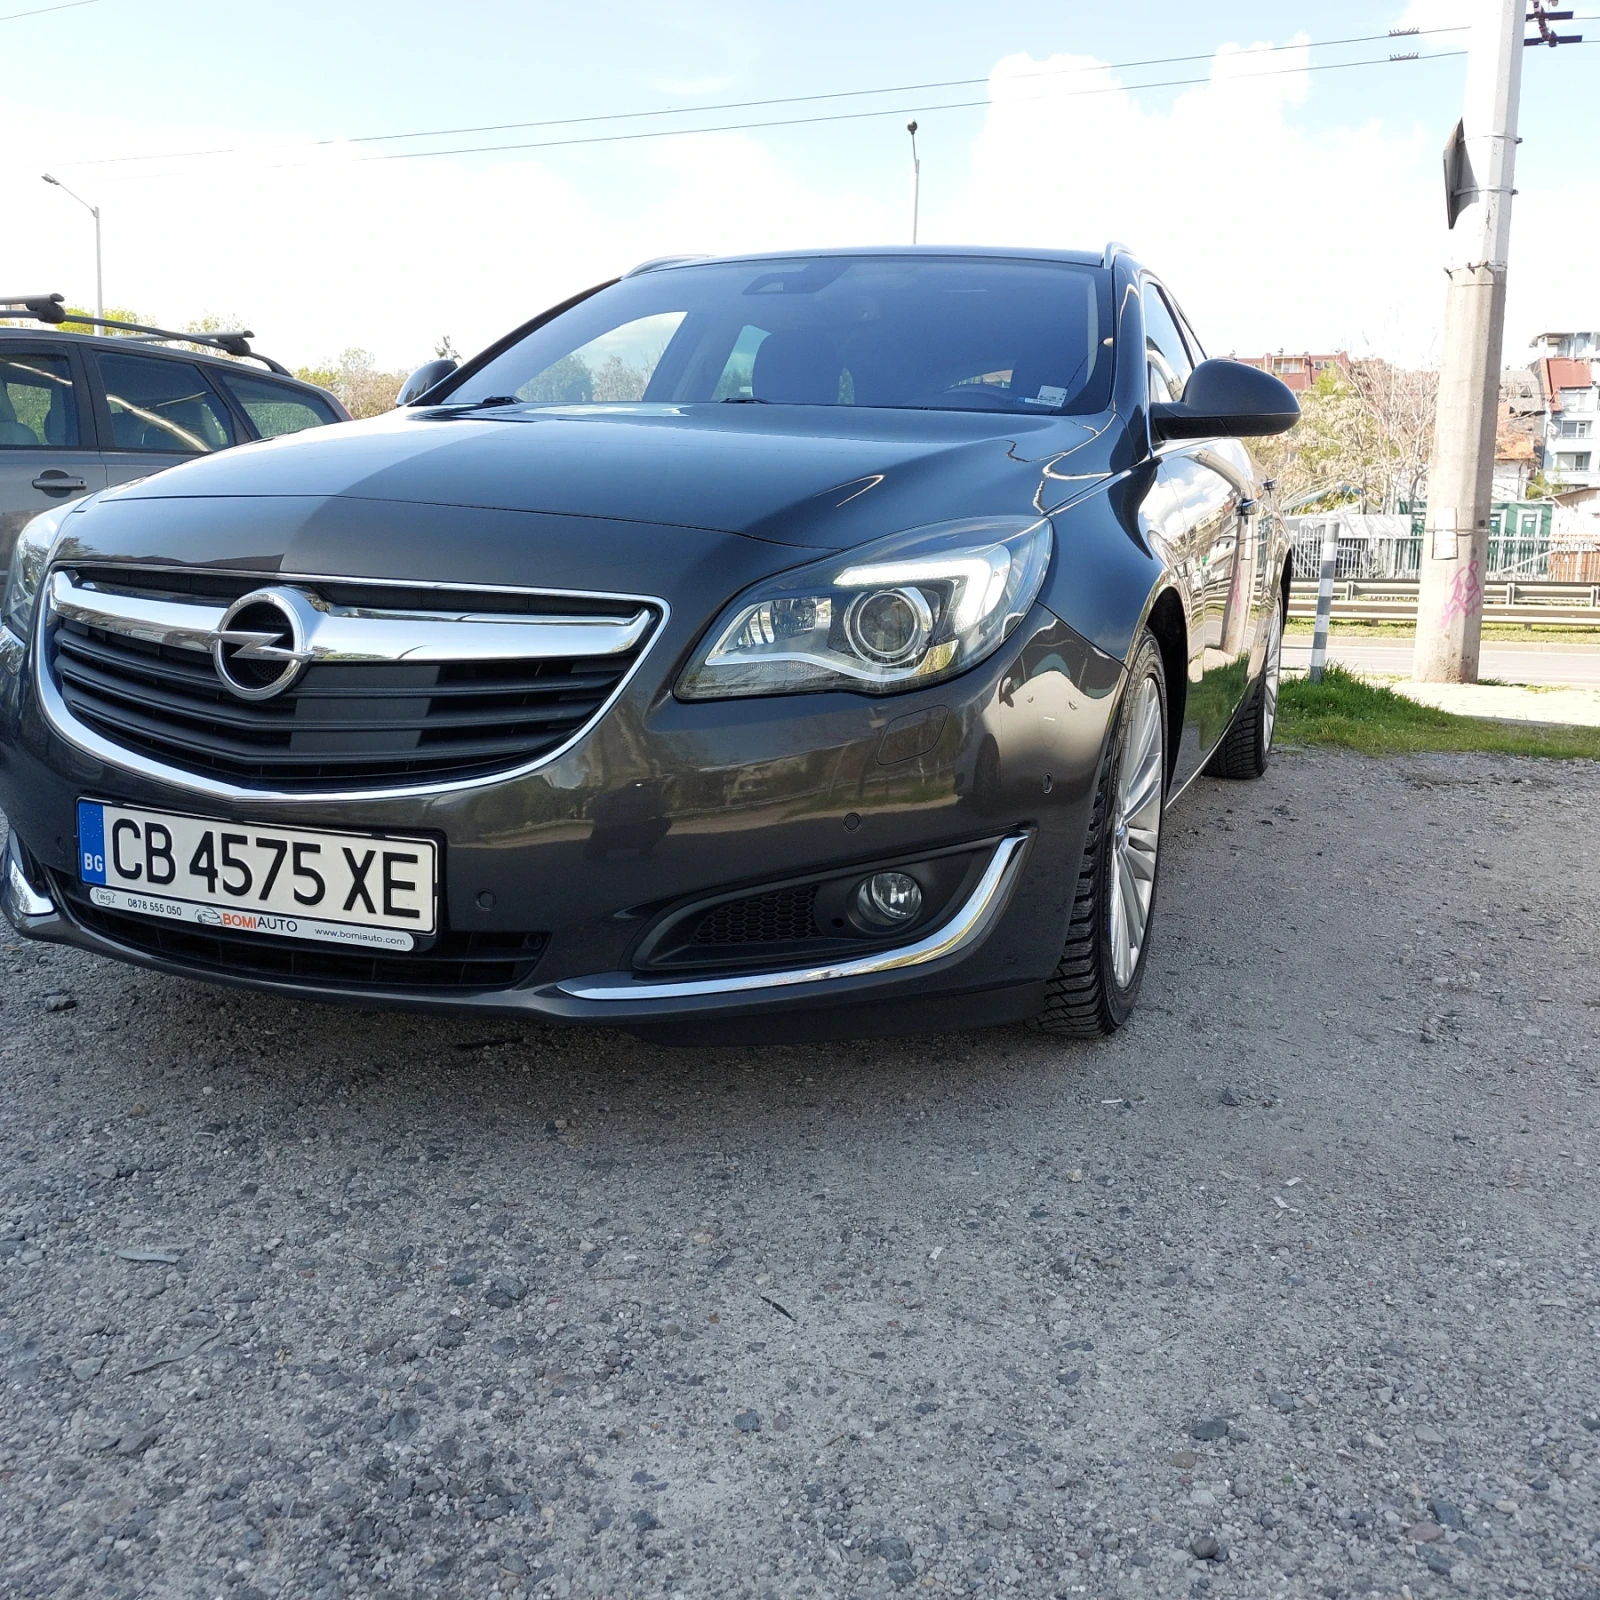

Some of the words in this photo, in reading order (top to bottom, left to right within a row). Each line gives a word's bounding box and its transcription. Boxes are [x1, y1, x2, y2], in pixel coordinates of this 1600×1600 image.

[84, 852, 103, 873] BG
[112, 818, 177, 885] CB
[189, 831, 326, 906] 4575
[342, 847, 420, 919] XE
[127, 898, 148, 910] 0878
[150, 902, 165, 913] 555
[166, 904, 182, 916] 050
[314, 927, 406, 946] www.bomiauto.com
